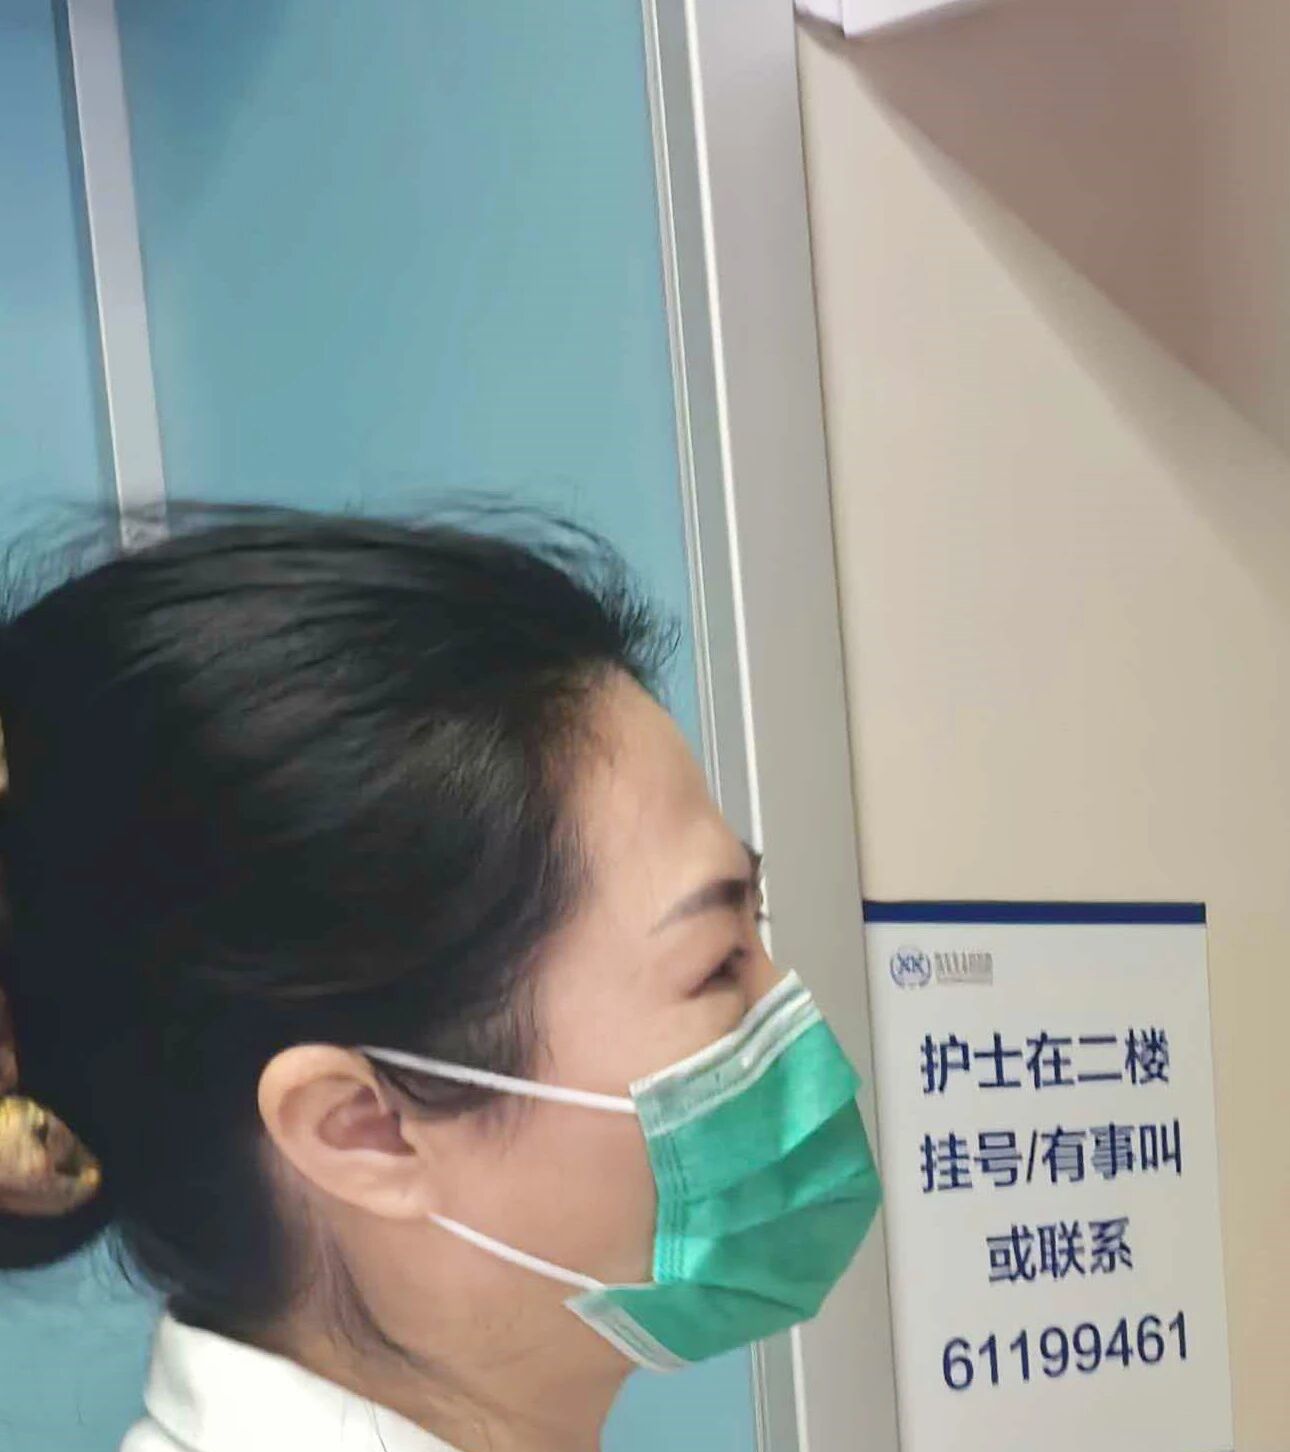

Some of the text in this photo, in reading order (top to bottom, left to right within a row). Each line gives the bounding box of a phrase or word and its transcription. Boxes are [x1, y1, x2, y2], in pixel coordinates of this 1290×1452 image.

[919, 1027, 1171, 1095] 护士在二楼
[919, 1119, 1183, 1194] 挂号/有事叫
[986, 1216, 1134, 1284] 或联系
[941, 1310, 1190, 1392] 61199461
